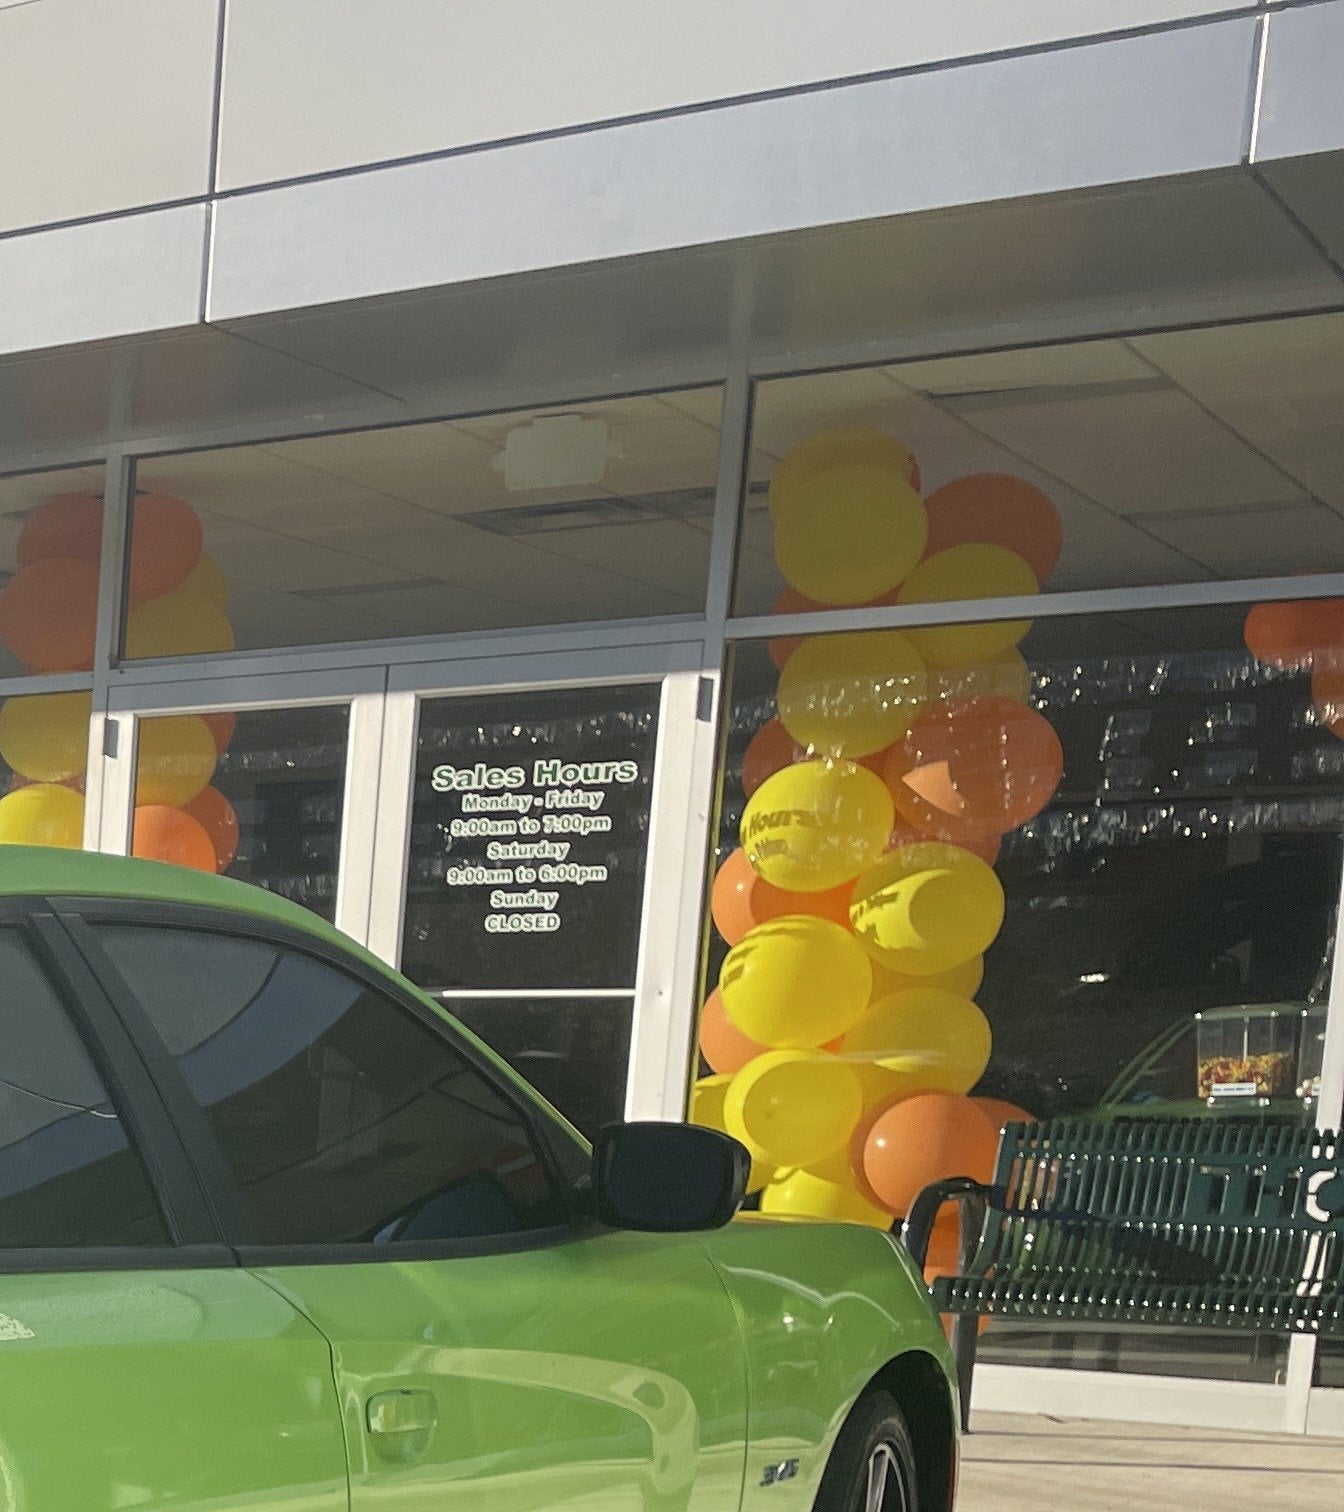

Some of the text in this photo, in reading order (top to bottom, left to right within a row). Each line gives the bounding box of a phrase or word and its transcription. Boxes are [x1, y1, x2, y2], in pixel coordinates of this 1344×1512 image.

[432, 760, 639, 791] Sales Hours
[462, 793, 534, 813] Monday
[544, 790, 605, 810] Friday
[451, 817, 517, 837] 9:00am
[519, 816, 540, 835] to
[486, 841, 571, 860] Saturday
[447, 864, 607, 886] 9:00am to 6:00pm
[490, 889, 559, 909] Sunday
[485, 913, 561, 932] CLOSED
